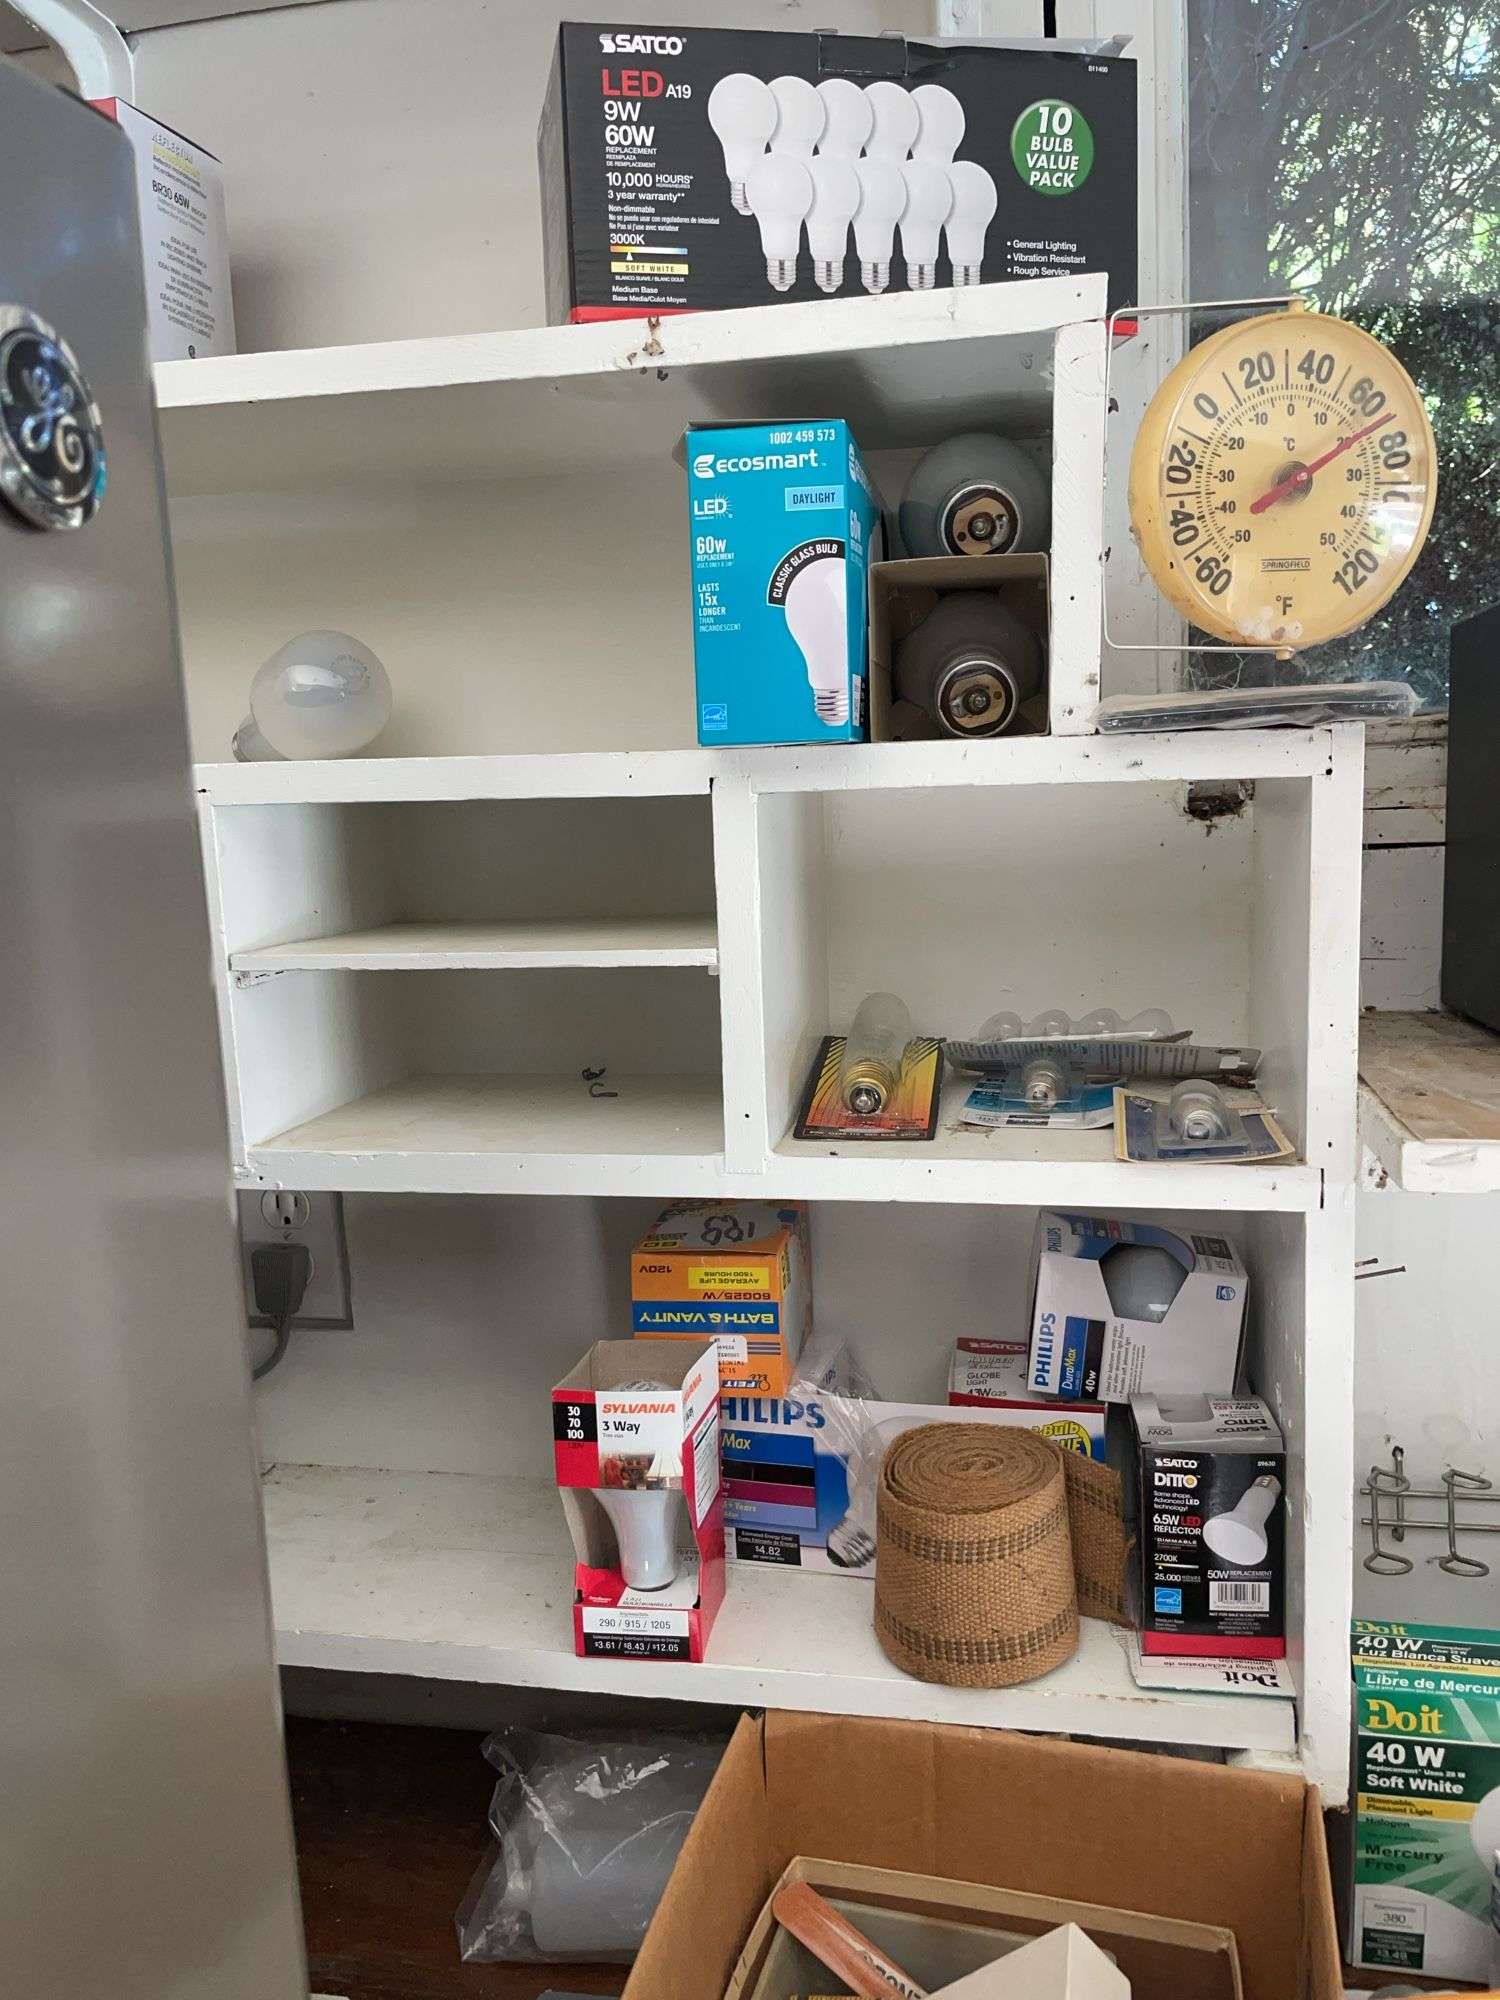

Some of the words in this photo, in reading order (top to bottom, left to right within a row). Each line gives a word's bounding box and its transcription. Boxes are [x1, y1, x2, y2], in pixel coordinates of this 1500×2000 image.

[615, 34, 684, 56] SATCO
[602, 68, 664, 97] LED
[665, 84, 692, 99] A19
[603, 100, 642, 122] 9W
[1038, 106, 1073, 136] 10
[605, 125, 655, 147] 60W
[605, 146, 657, 155] REPLACEMENT
[1031, 135, 1074, 153] BULB
[1026, 152, 1080, 171] VALUE
[605, 172, 653, 189] 10,000
[1029, 171, 1075, 188] PACK
[152, 179, 173, 200] BR30
[173, 192, 190, 209] 65W
[607, 190, 614, 199] 3
[616, 191, 636, 201] year
[608, 205, 656, 214] Non-dimmable
[609, 233, 645, 245] 3000K
[1013, 239, 1044, 249] General
[1045, 241, 1077, 252] Lighting
[1013, 253, 1048, 262] Vibration
[1049, 255, 1086, 264] Resistant
[1013, 266, 1040, 277] Rough
[1041, 266, 1071, 277] Service
[612, 285, 640, 293] Medium
[641, 286, 659, 294] Base
[1238, 350, 1276, 390] 20
[1297, 349, 1336, 385] 40
[1349, 376, 1387, 418] 60
[1193, 392, 1219, 420] 0
[1287, 403, 1296, 417] 0
[1248, 412, 1268, 426] -10
[1313, 412, 1328, 426] 10
[769, 431, 792, 445] 1002
[795, 430, 815, 443] 459
[816, 428, 836, 442] 573
[1222, 436, 1245, 451] -20
[1282, 436, 1296, 452] °C
[1378, 430, 1411, 470] 80
[716, 448, 820, 474] ecosmart
[1165, 440, 1197, 485] -20
[1212, 469, 1235, 483] -30
[1346, 467, 1363, 481] 30
[792, 492, 836, 505] DAYLIGHT
[693, 499, 727, 516] LED
[1214, 500, 1236, 514] -40
[1340, 504, 1356, 518] 40
[1169, 500, 1200, 547] -40
[1229, 528, 1251, 543] -50
[1319, 532, 1336, 546] 50
[696, 552, 735, 562] REPLACEMENT
[772, 562, 794, 598] CLASSIC
[790, 545, 816, 567] GLASS
[815, 543, 839, 555] BULB
[1261, 560, 1311, 569] SPRINGFIELD
[1331, 547, 1380, 596] 120
[1194, 554, 1233, 596] -60
[697, 582, 720, 593] LASTS
[699, 592, 719, 607] 15x
[1275, 594, 1294, 616] °F
[698, 606, 727, 617] LONGER
[699, 616, 714, 624] THAN
[699, 623, 741, 633] INCANDESCENT
[638, 1263, 673, 1274] 120V
[698, 1277, 722, 1285] LIFE
[723, 1277, 760, 1285] AVERAGE
[702, 1291, 771, 1301] 60G25/W
[639, 1311, 706, 1324] VANITY
[709, 1312, 723, 1324] &
[724, 1312, 775, 1325] BATH
[981, 1341, 1027, 1351] SATCO
[1034, 1312, 1057, 1387] PHILIPS
[967, 1371, 1001, 1380] GLOBE
[1061, 1347, 1078, 1391] DuraMax
[724, 1380, 757, 1389] FEIT
[966, 1379, 988, 1387] LIGHT
[967, 1387, 992, 1398] 43W
[567, 1405, 580, 1416] 30
[602, 1403, 676, 1415] SYLVANIA
[568, 1417, 581, 1428] 70
[602, 1421, 610, 1431] 3
[612, 1420, 641, 1435] Way
[566, 1429, 584, 1440] 100
[1163, 1458, 1198, 1469] SATCO
[1153, 1497, 1185, 1505] Advanced
[1153, 1513, 1180, 1526] 6.5W
[1181, 1515, 1201, 1527] LED
[1154, 1524, 1202, 1535] REFLECTOR
[754, 1545, 781, 1556] $4.82
[1154, 1552, 1178, 1562] 2700K
[1207, 1569, 1230, 1580] 50W
[599, 1618, 616, 1628] 290
[624, 1619, 641, 1629] 915
[650, 1620, 671, 1630] 1205
[594, 1641, 616, 1650] $3.61
[623, 1643, 645, 1652] $8.43
[652, 1644, 679, 1653] $12.05
[1356, 1636, 1389, 1649] 40
[1395, 1638, 1424, 1651] W
[1358, 1647, 1387, 1657] Luz
[1391, 1649, 1446, 1662] Blanca
[1450, 1654, 1500, 1668] Suave
[1366, 1673, 1409, 1687] Libre
[1414, 1678, 1436, 1690] de
[1366, 1741, 1406, 1765] 40
[1413, 1745, 1446, 1768] W
[1366, 1773, 1405, 1789] Soft
[1408, 1777, 1465, 1795] White
[1366, 1803, 1407, 1814] Pleasant
[1409, 1807, 1434, 1816] Light
[1366, 1817, 1411, 1828] Halogen
[1365, 1845, 1445, 1864] Mercury
[1365, 1858, 1406, 1873] Free
[1383, 1912, 1407, 1925] 380
